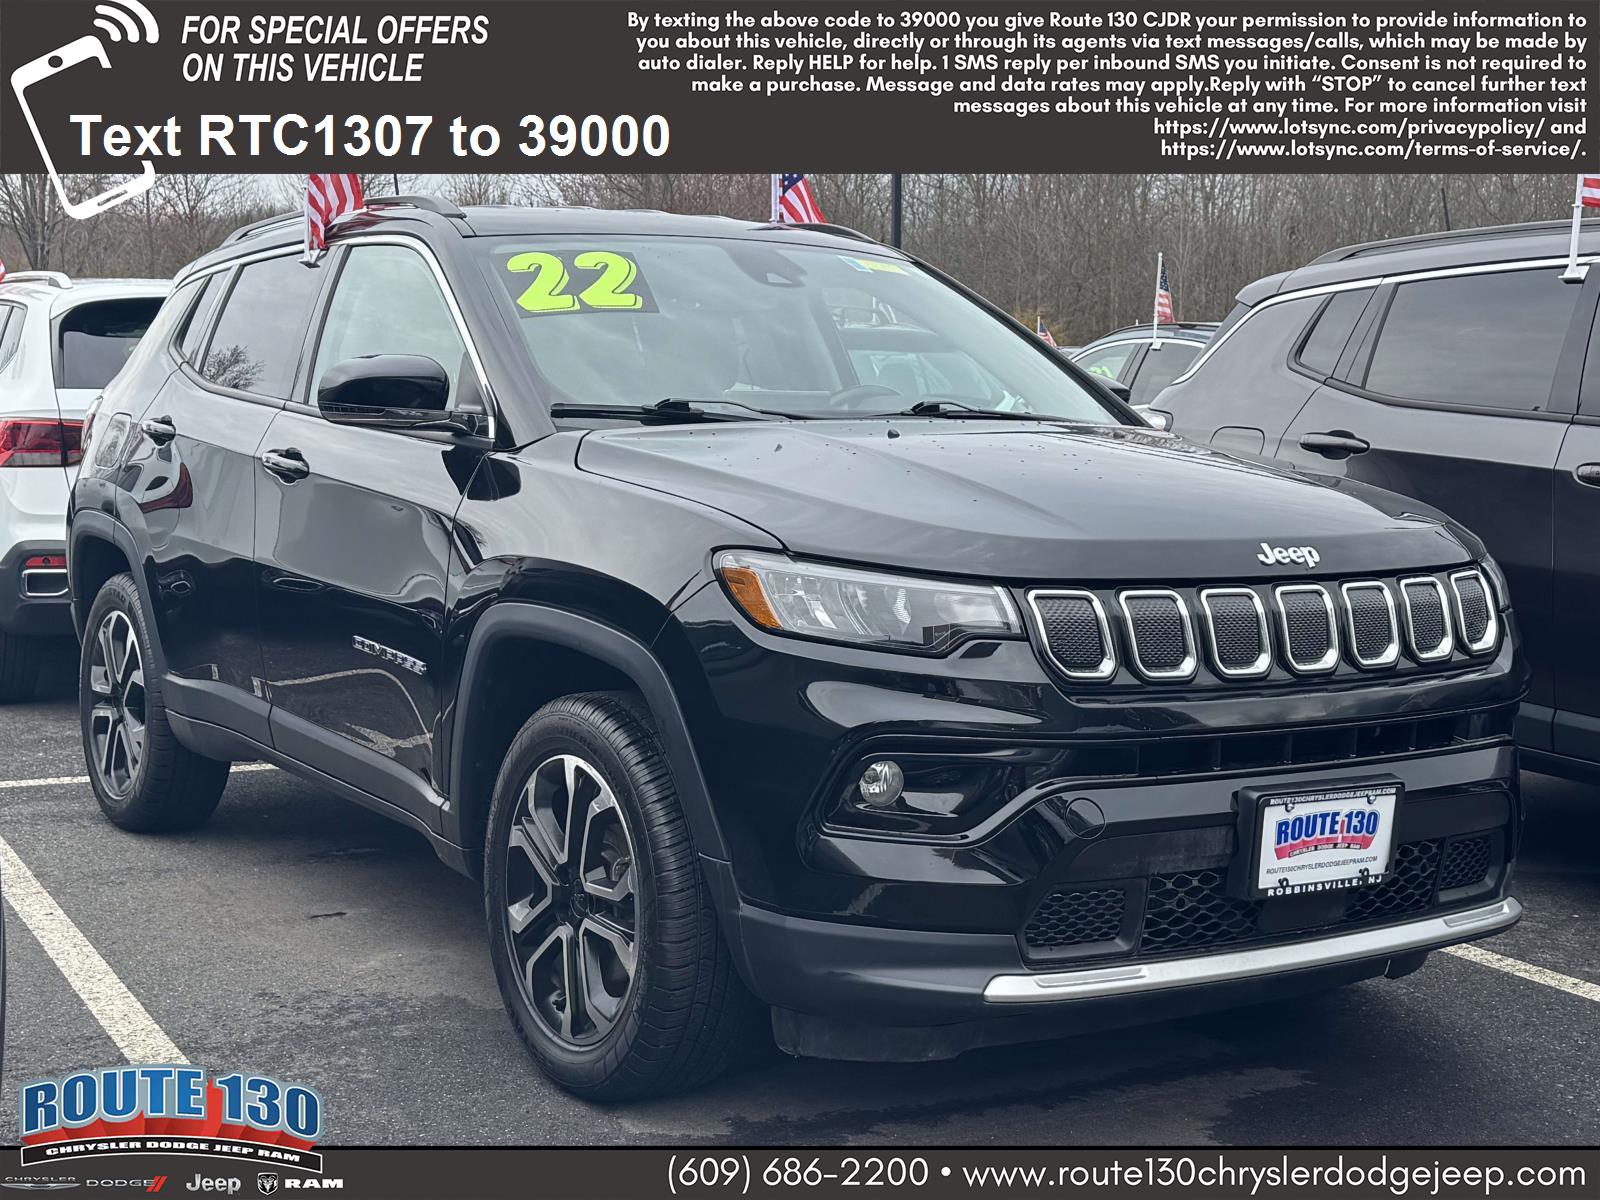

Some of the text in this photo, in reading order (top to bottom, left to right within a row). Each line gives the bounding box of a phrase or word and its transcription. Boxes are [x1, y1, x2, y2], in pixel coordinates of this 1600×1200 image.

[507, 251, 643, 312] 22
[1256, 542, 1321, 568] Jeep
[1276, 809, 1379, 845] ROUTE 130
[1267, 875, 1382, 897] ROBBINSVILLE, NJ
